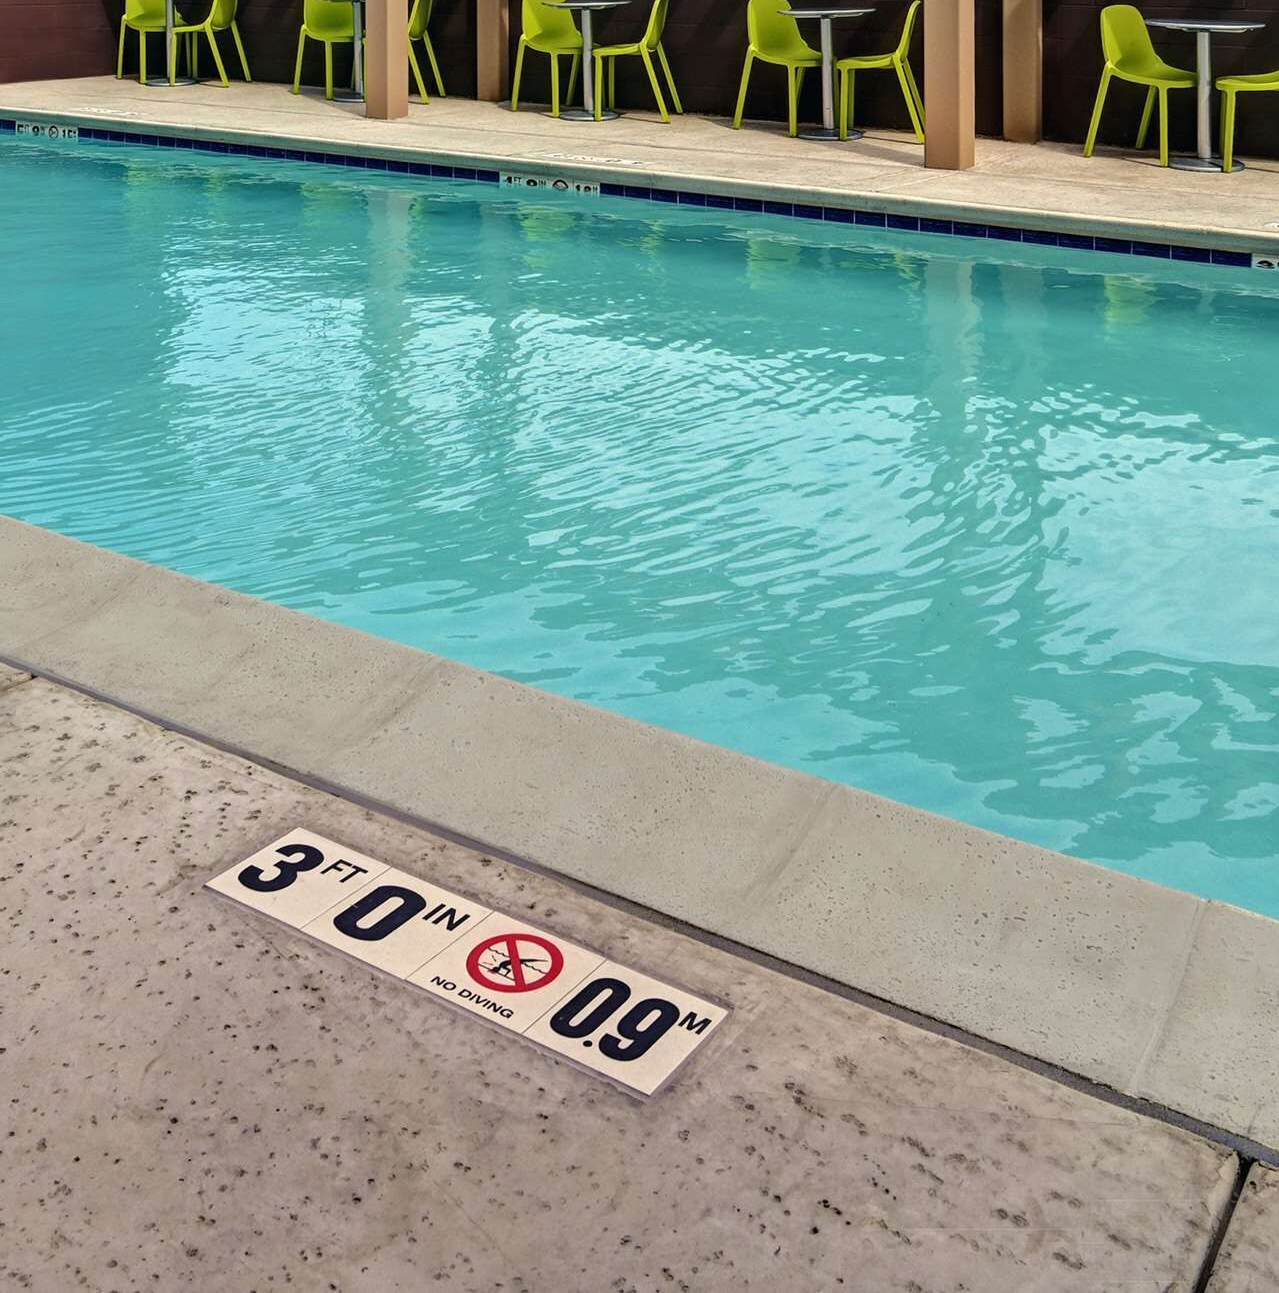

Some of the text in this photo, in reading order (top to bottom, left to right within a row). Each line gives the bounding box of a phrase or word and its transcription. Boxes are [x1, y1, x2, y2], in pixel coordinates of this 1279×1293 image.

[237, 843, 470, 942] 3 FT 0 IN
[430, 974, 515, 1019] NO DIVING
[548, 977, 711, 1062] 0.9 M
